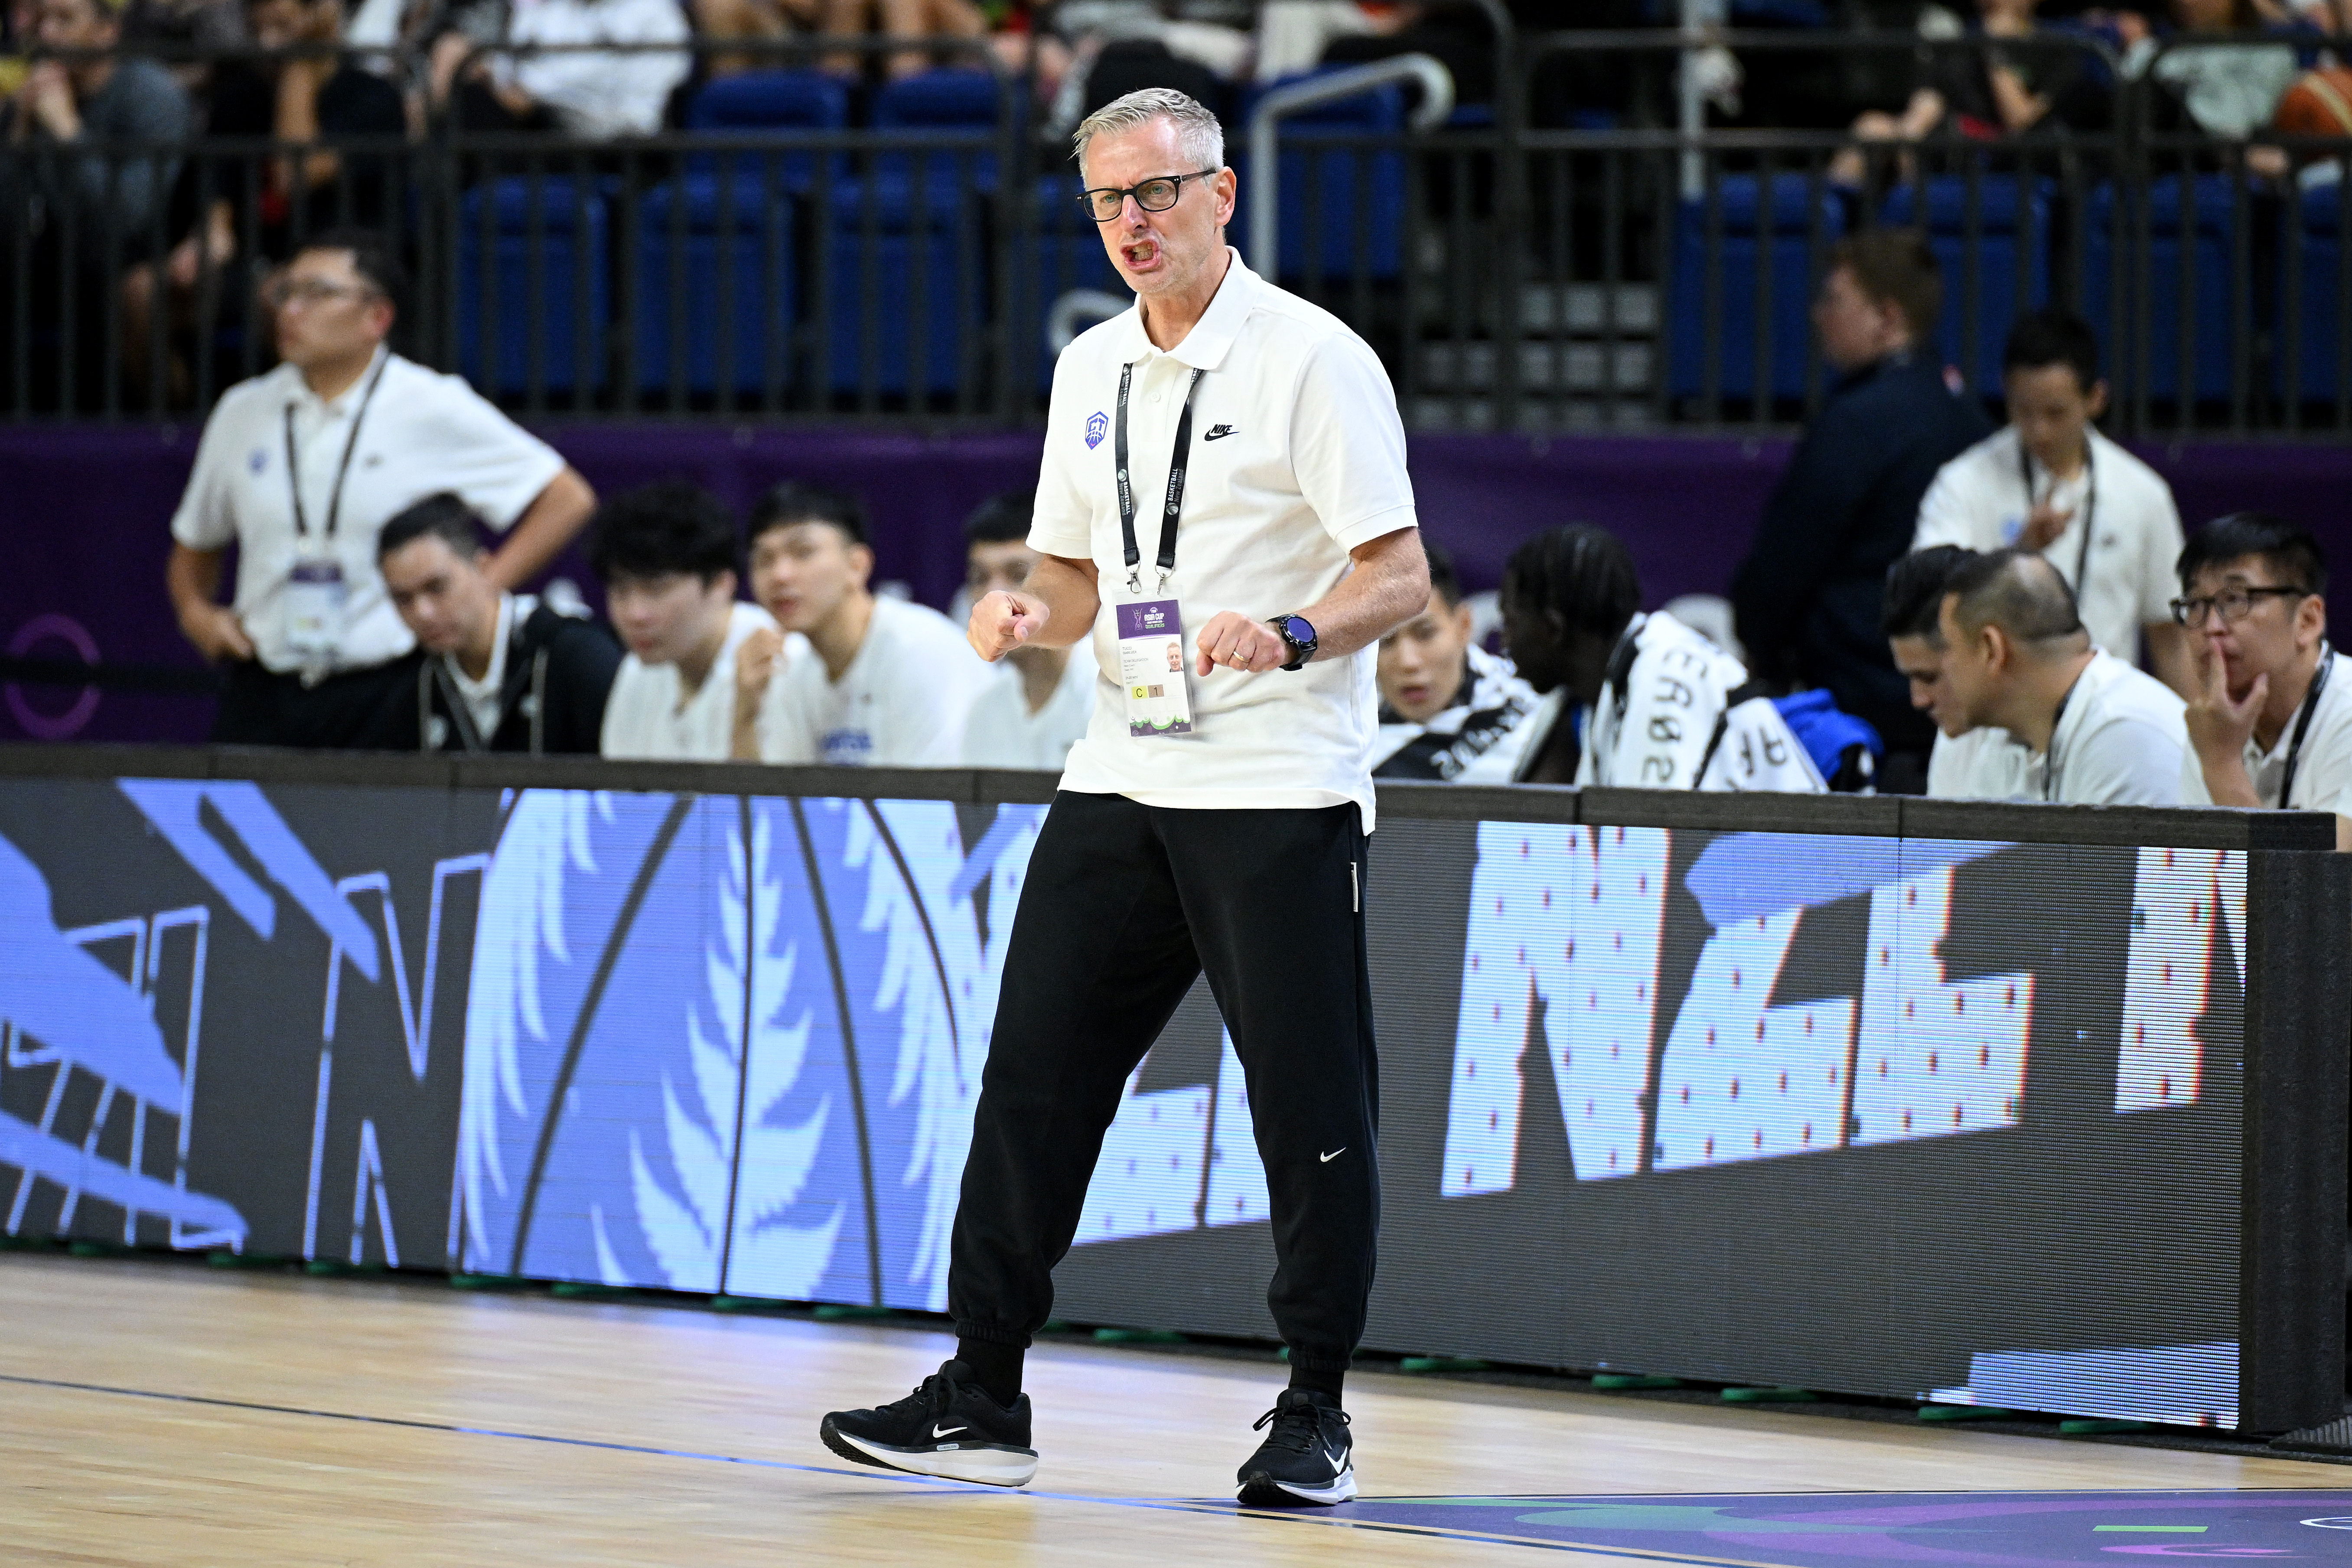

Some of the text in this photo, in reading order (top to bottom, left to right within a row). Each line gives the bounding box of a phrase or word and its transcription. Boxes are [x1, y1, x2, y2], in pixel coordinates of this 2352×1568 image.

[1211, 424, 1232, 435] NIKE
[1168, 468, 1178, 501] BASKETBALL
[1176, 468, 1184, 490] Zealand
[1136, 688, 1143, 697] C
[1153, 686, 1158, 696] 1
